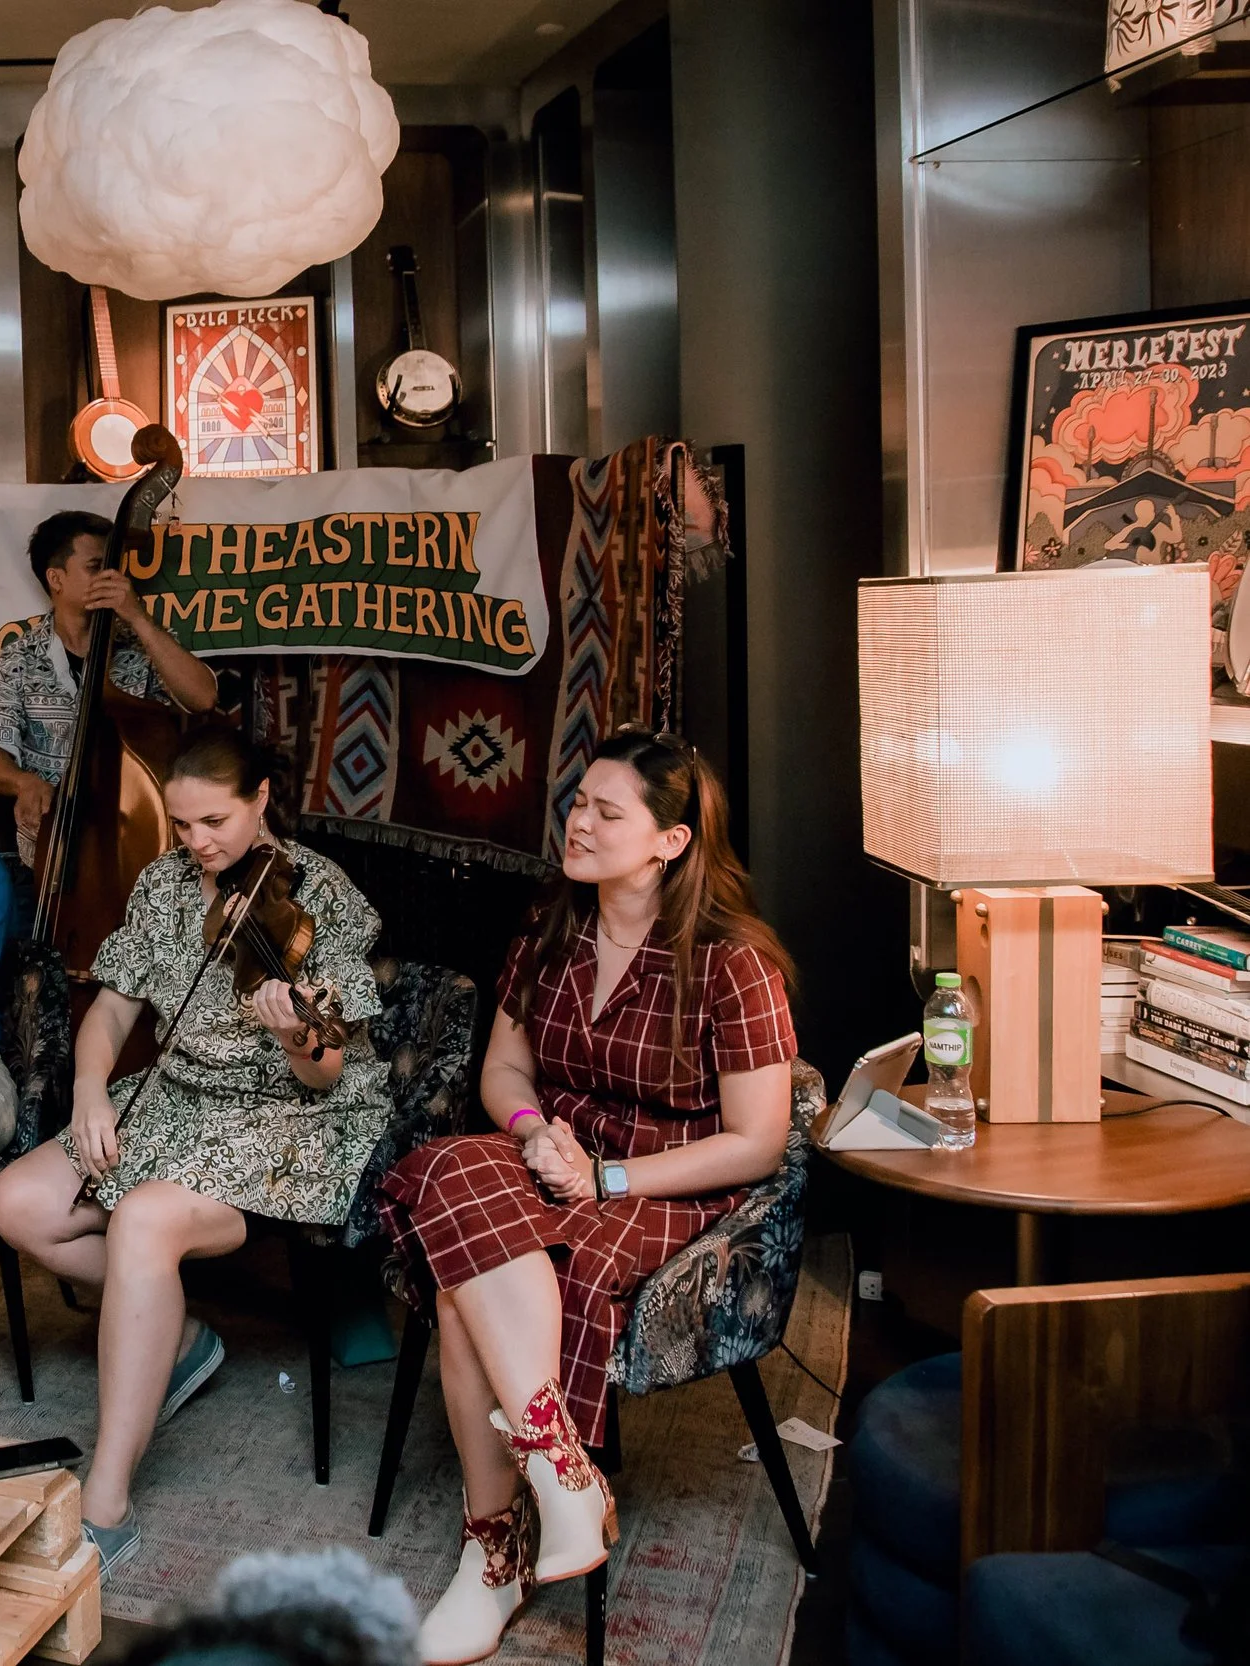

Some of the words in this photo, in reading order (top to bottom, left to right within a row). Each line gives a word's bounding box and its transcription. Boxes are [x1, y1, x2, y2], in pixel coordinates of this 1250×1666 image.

[1065, 324, 1247, 372] MERLEFEST
[1079, 370, 1128, 390] APRIL
[1190, 361, 1228, 380] 2023
[262, 467, 291, 476] HEART
[121, 511, 481, 580] UTHEASTERN
[142, 587, 249, 634] IME
[255, 581, 536, 656] GATHERING
[929, 1042, 963, 1052] NAMTHIP
[1164, 1020, 1182, 1034] DARK
[1183, 1025, 1209, 1042] KNIGHT
[1210, 1035, 1240, 1054] TRILOGY
